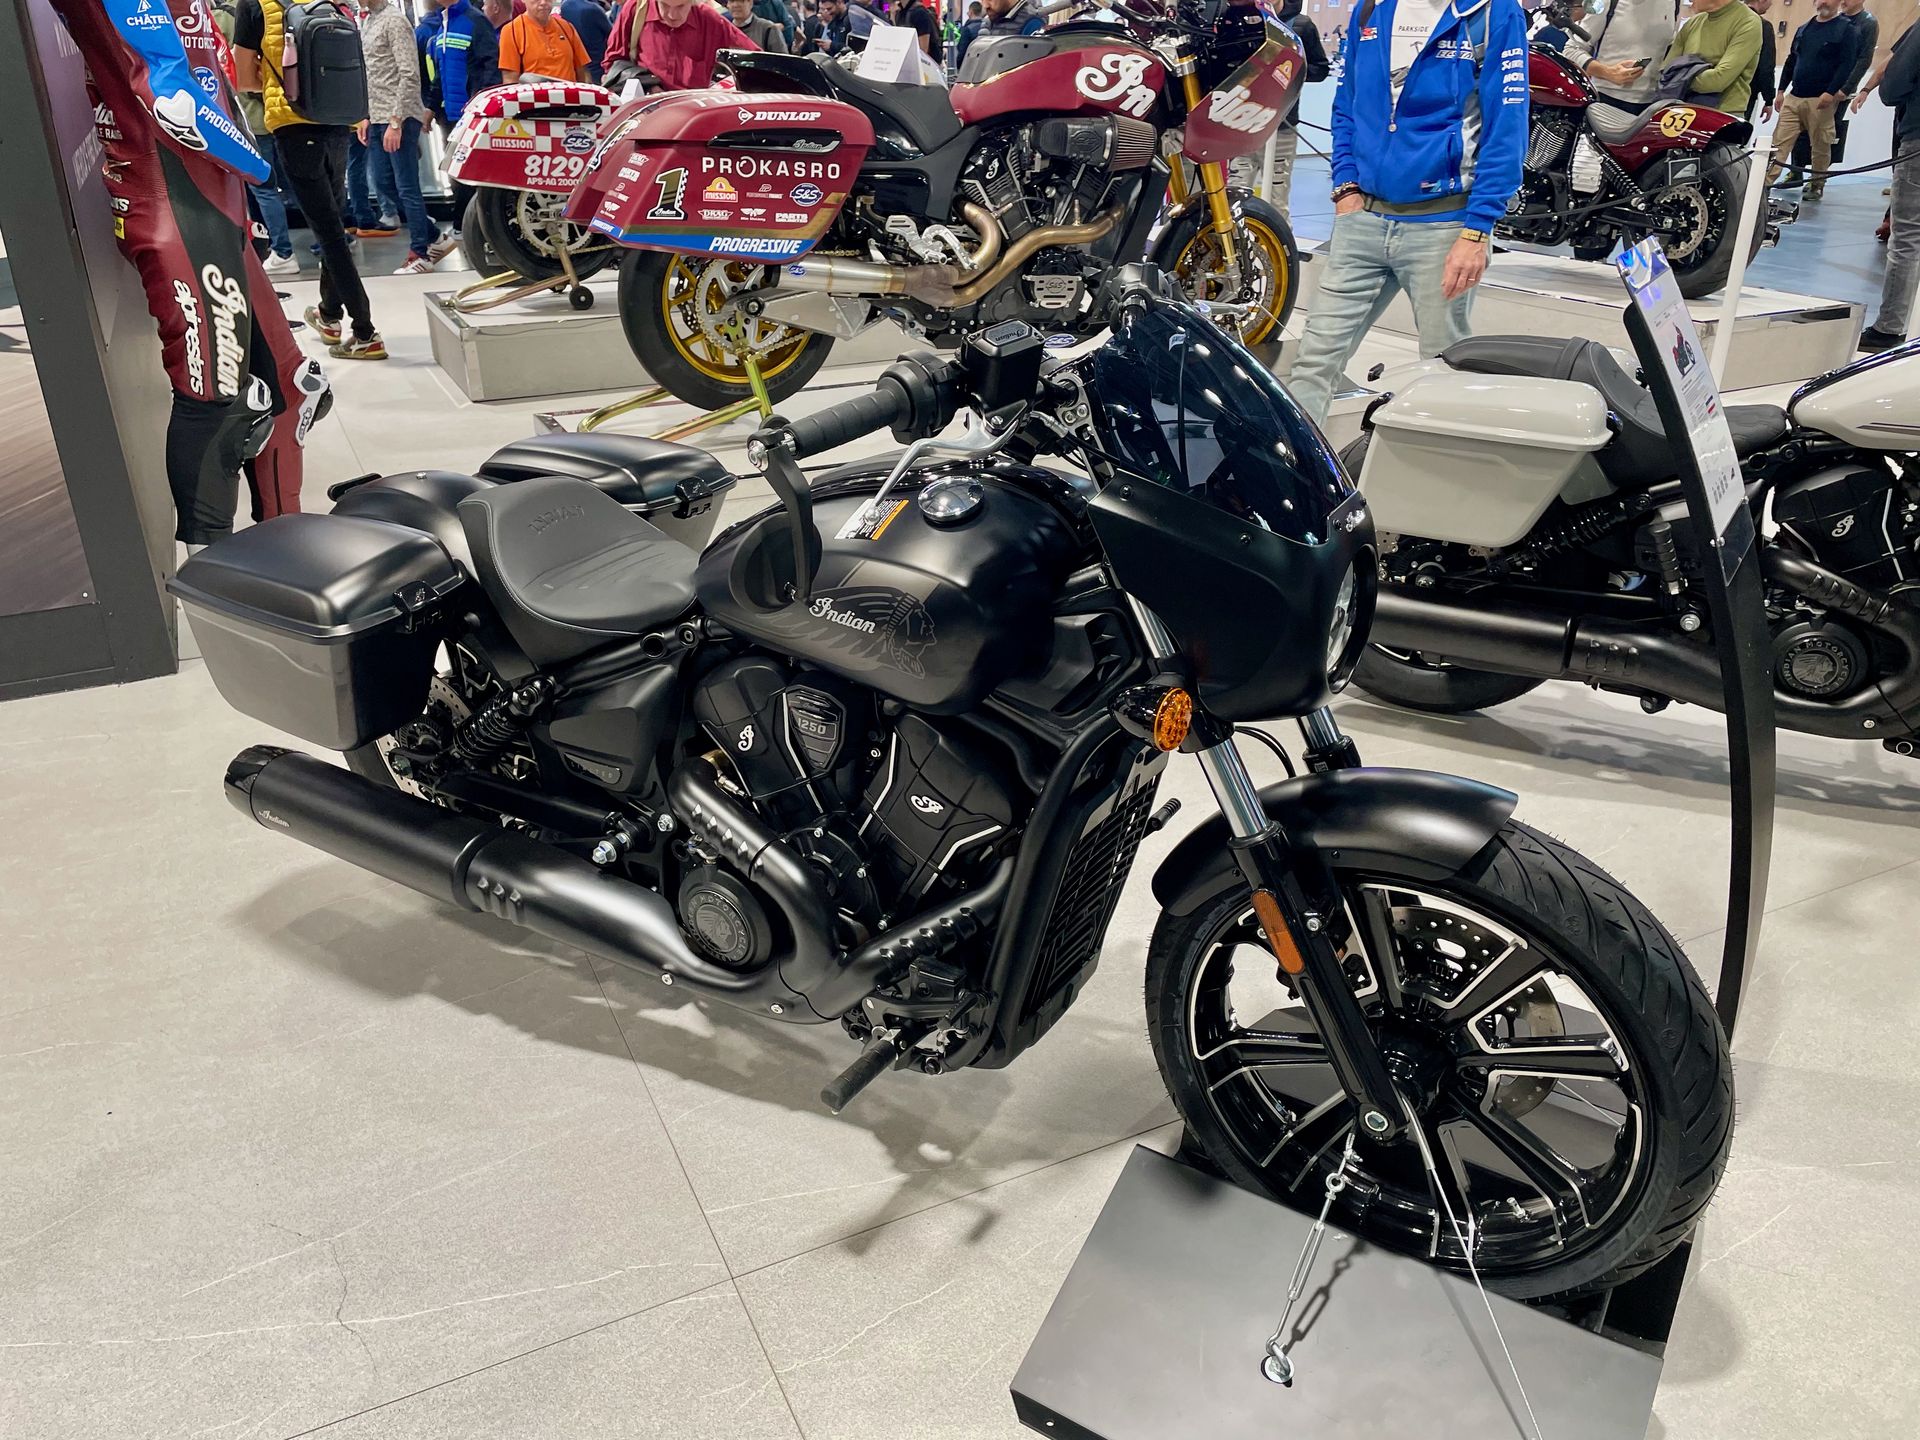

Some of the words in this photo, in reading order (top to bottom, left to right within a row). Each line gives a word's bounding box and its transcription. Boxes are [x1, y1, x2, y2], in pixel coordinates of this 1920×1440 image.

[126, 15, 171, 27] CHÂTEL
[1398, 25, 1428, 33] PARKSIDE
[753, 111, 822, 121] DUNLOP
[566, 137, 591, 147] S&S
[524, 154, 585, 178] 8129
[702, 155, 841, 180] PROKASRO
[646, 167, 688, 220] 1
[794, 188, 819, 200] S&S
[708, 236, 803, 254] PROGRESSIVE
[173, 278, 205, 396] alpinestars
[202, 263, 248, 397] Indian
[808, 597, 876, 634] Indian
